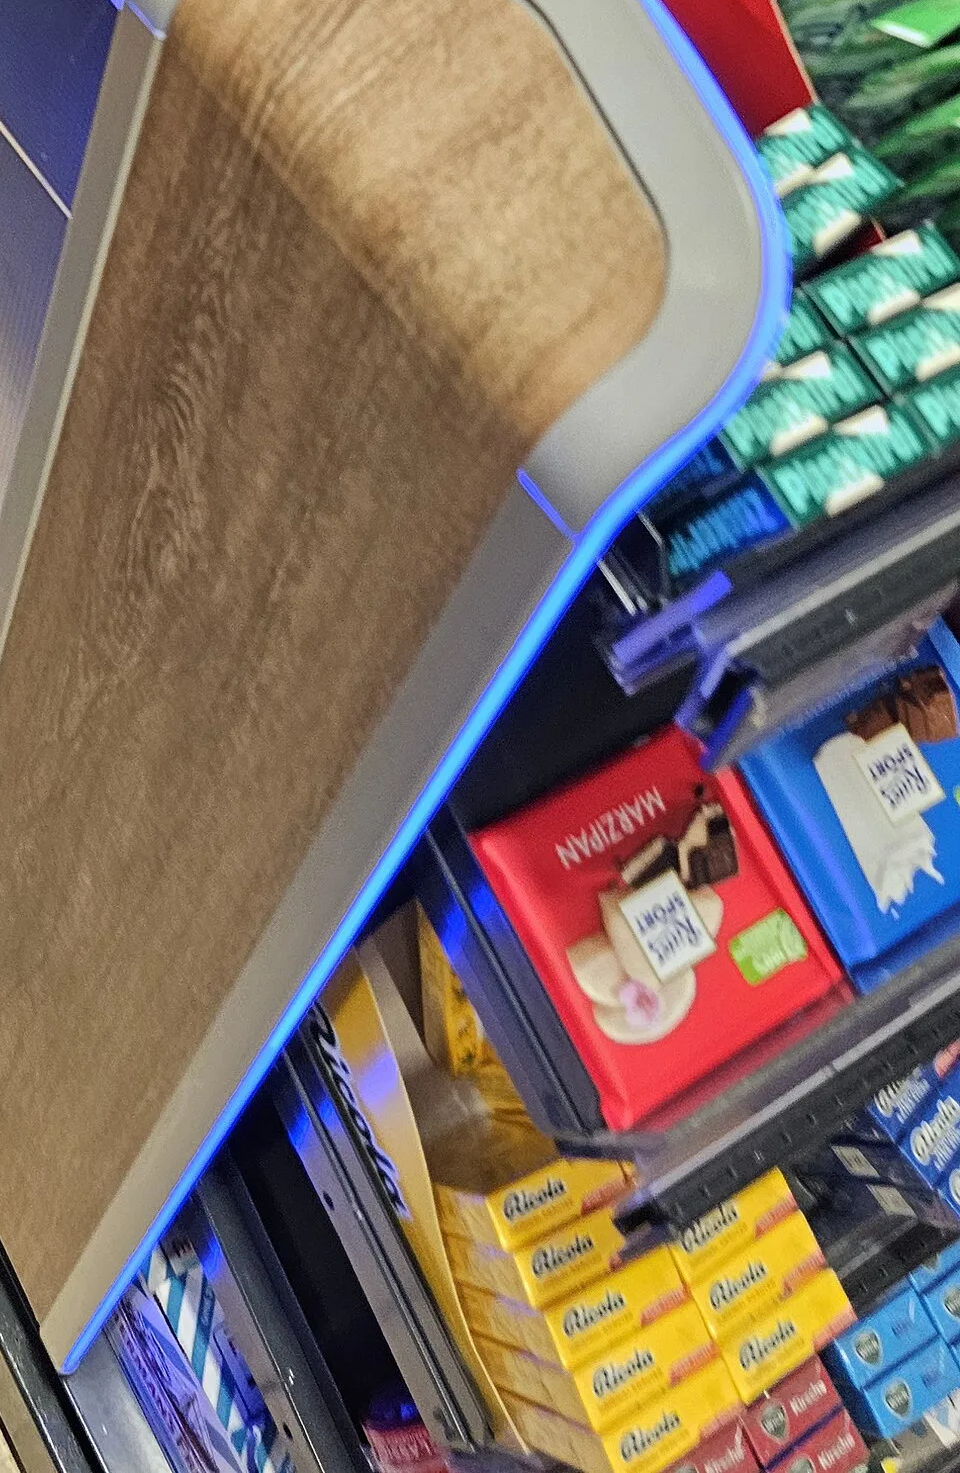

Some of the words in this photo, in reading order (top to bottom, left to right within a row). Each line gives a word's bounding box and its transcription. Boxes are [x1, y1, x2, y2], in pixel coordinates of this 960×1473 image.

[553, 785, 667, 871] MARZIPAN
[633, 889, 687, 939] SPORT
[502, 1176, 567, 1223] Ricola
[679, 1201, 740, 1255] Ricola
[531, 1233, 595, 1279] Ricola
[708, 1259, 769, 1312] Ricola
[562, 1289, 626, 1339] Ricola
[739, 1319, 797, 1373] Ricola
[592, 1348, 655, 1399] Ricola
[619, 1409, 682, 1463] Ricola
